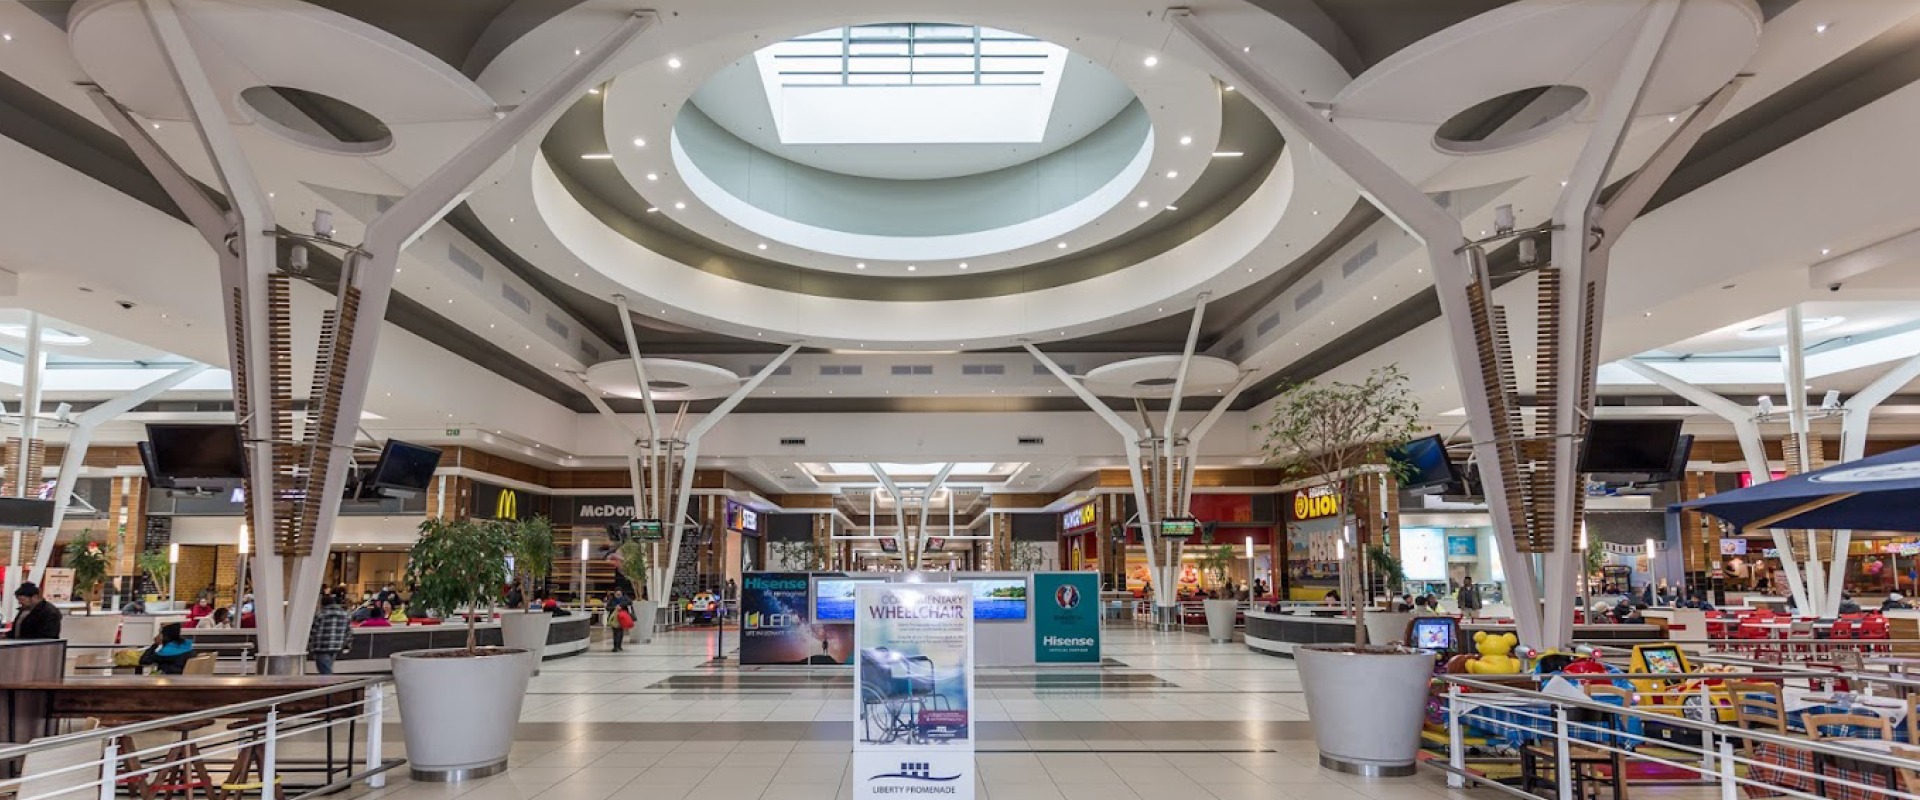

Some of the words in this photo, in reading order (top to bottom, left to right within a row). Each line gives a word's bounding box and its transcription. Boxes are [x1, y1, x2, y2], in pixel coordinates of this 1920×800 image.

[580, 505, 634, 517] McDon
[744, 578, 807, 589] Hisense
[869, 605, 963, 619] WHEELCHAIR
[1043, 635, 1094, 646] Hisense
[872, 785, 904, 794] LIBERTY
[905, 785, 956, 794] PROMENADE
